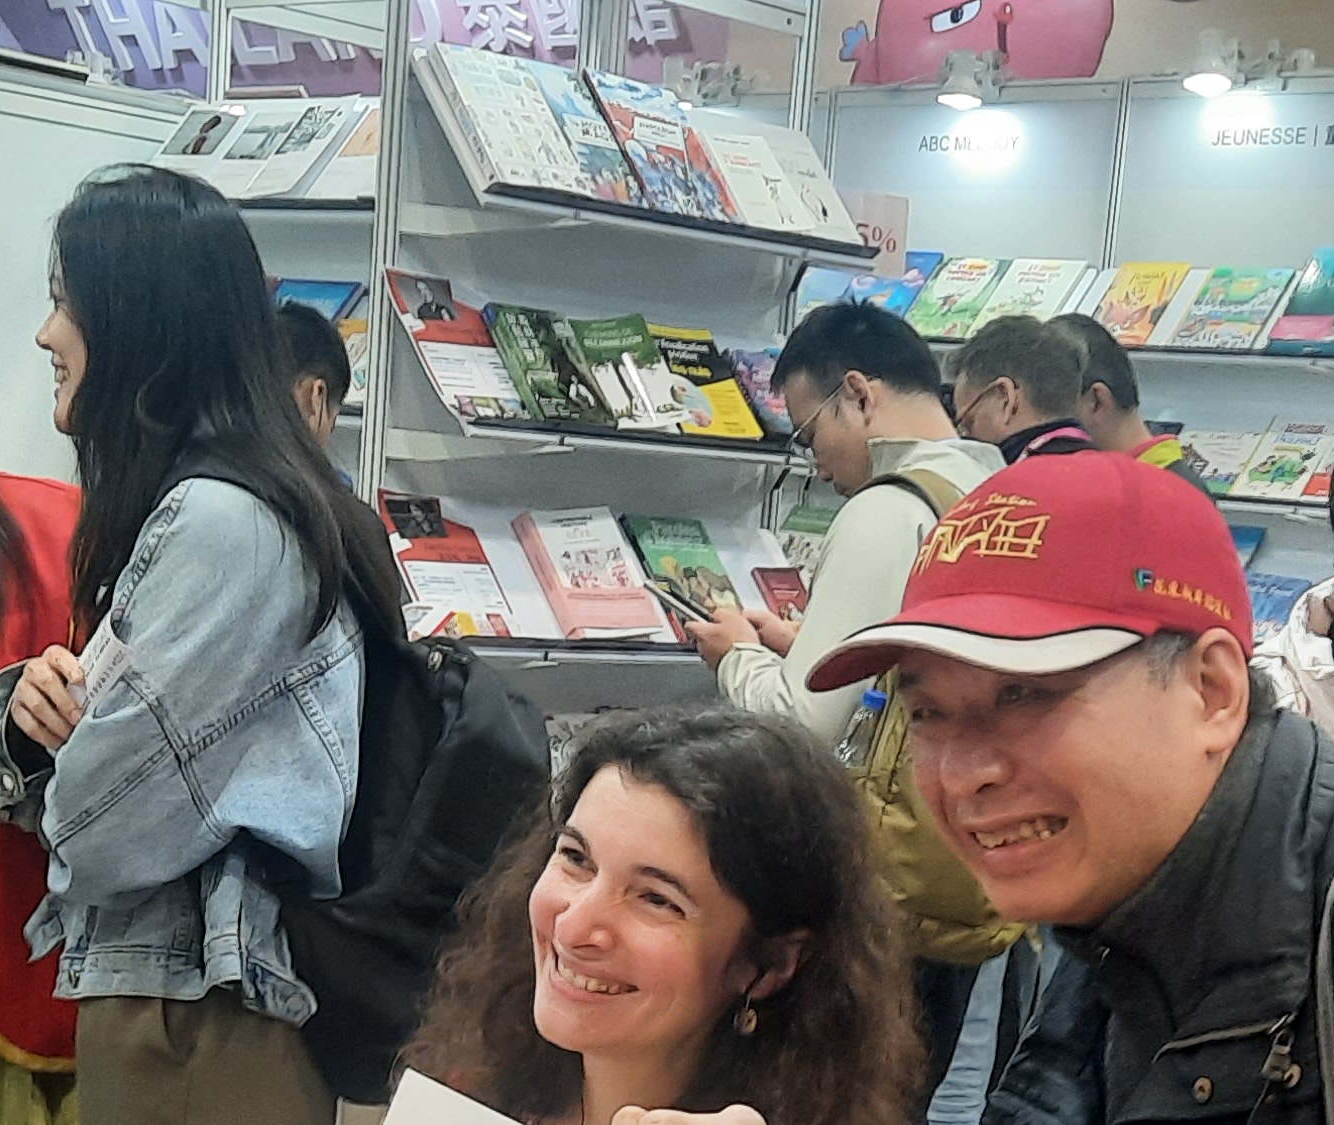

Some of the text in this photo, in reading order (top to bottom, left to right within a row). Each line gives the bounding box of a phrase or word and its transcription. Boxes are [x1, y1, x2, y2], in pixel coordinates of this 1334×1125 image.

[918, 134, 1020, 153] ABC MEDY
[1211, 126, 1307, 147] JEUNESSE
